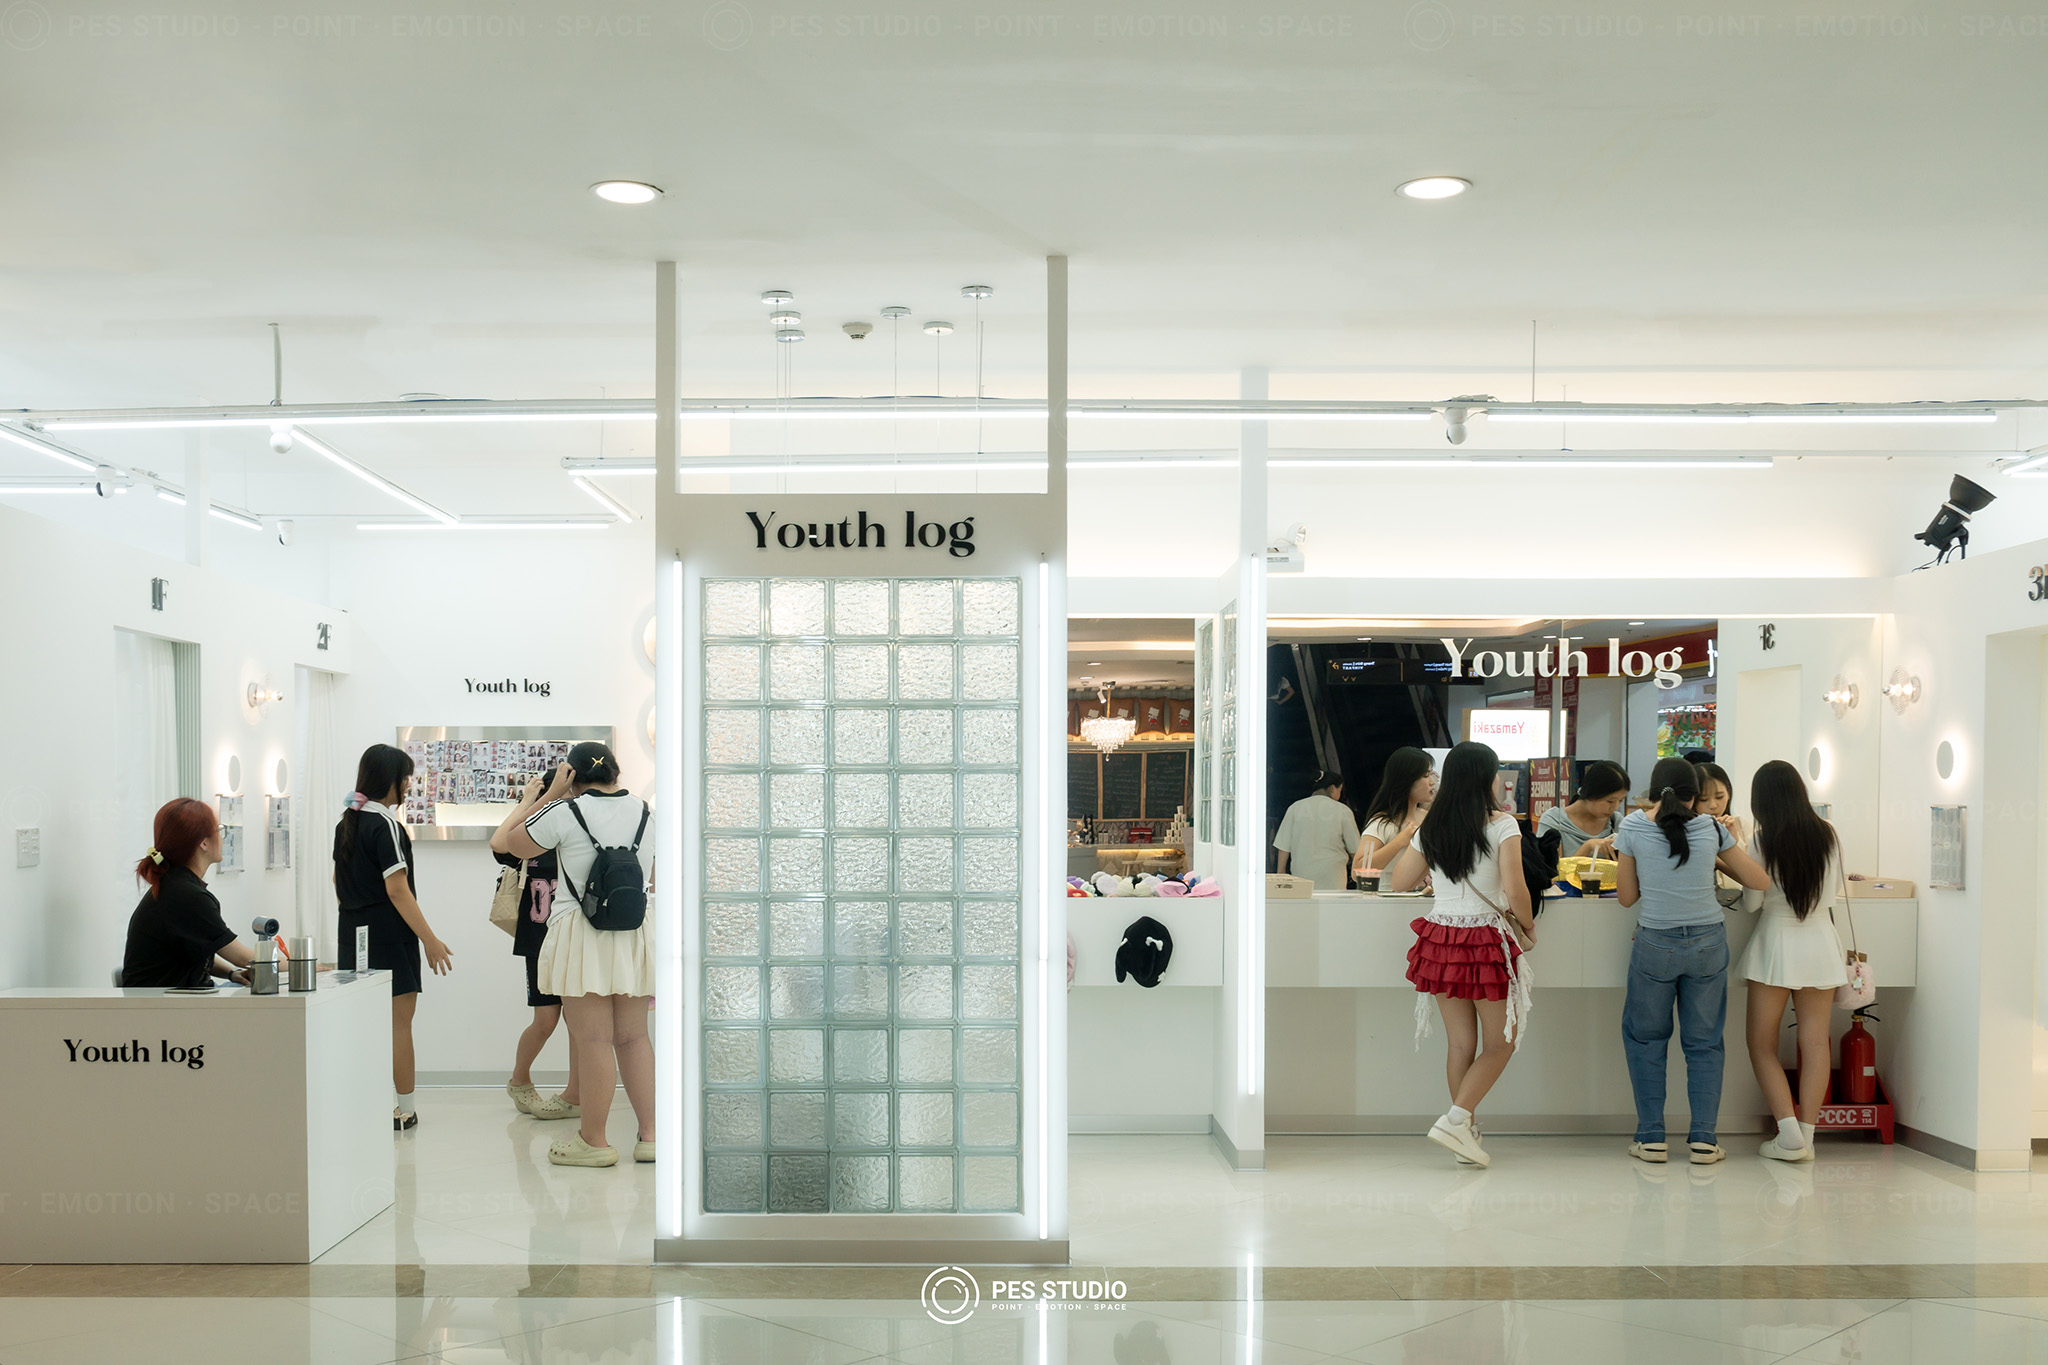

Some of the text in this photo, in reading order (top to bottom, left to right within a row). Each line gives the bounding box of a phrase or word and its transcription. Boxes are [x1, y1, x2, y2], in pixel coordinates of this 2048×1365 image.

[746, 510, 976, 558] Youth log
[317, 622, 332, 650] 2F
[1440, 637, 1588, 678] Youth
[1607, 637, 1684, 690] log
[465, 678, 551, 698] Youth log
[64, 1039, 205, 1070] Youth log
[1816, 1109, 1857, 1124] PCCC
